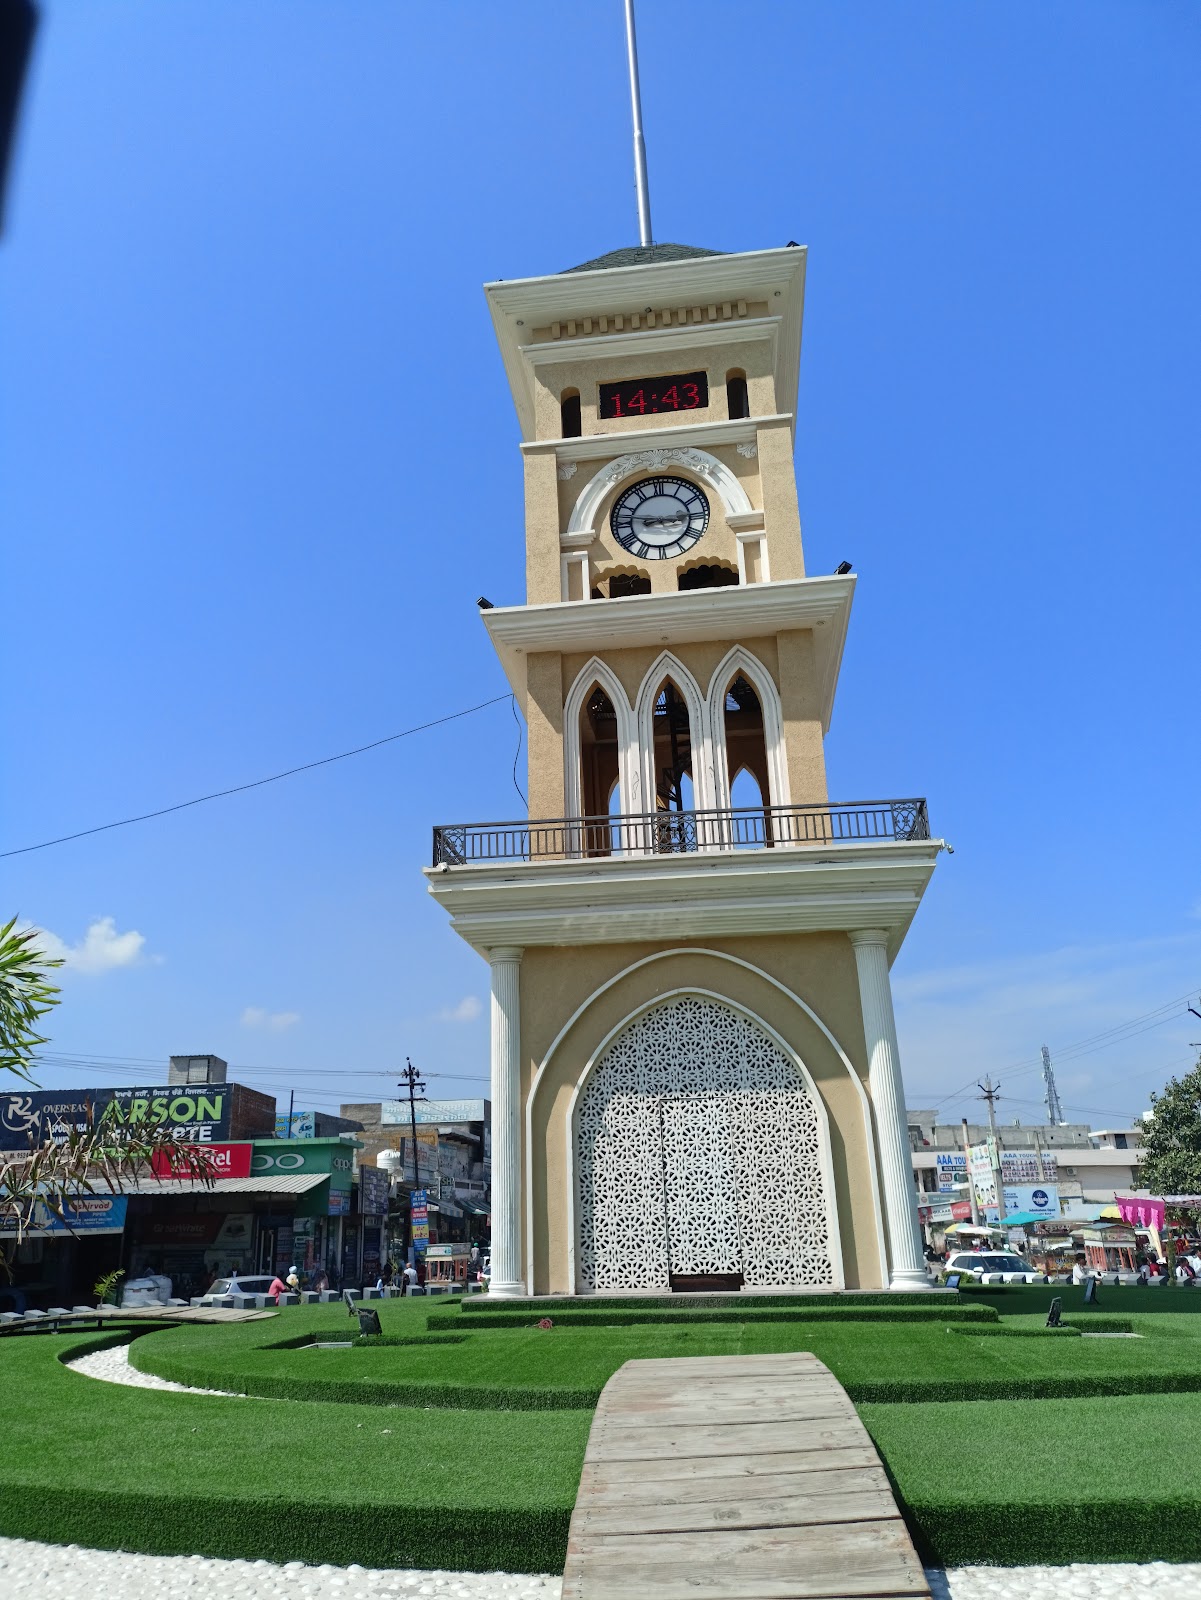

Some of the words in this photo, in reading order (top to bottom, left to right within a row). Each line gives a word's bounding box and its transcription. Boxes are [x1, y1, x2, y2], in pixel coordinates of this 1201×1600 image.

[611, 383, 700, 418] 14:43
[43, 1103, 88, 1114] OVERSEAS
[937, 1154, 953, 1165] AAA
[71, 1201, 110, 1211] shirvad
